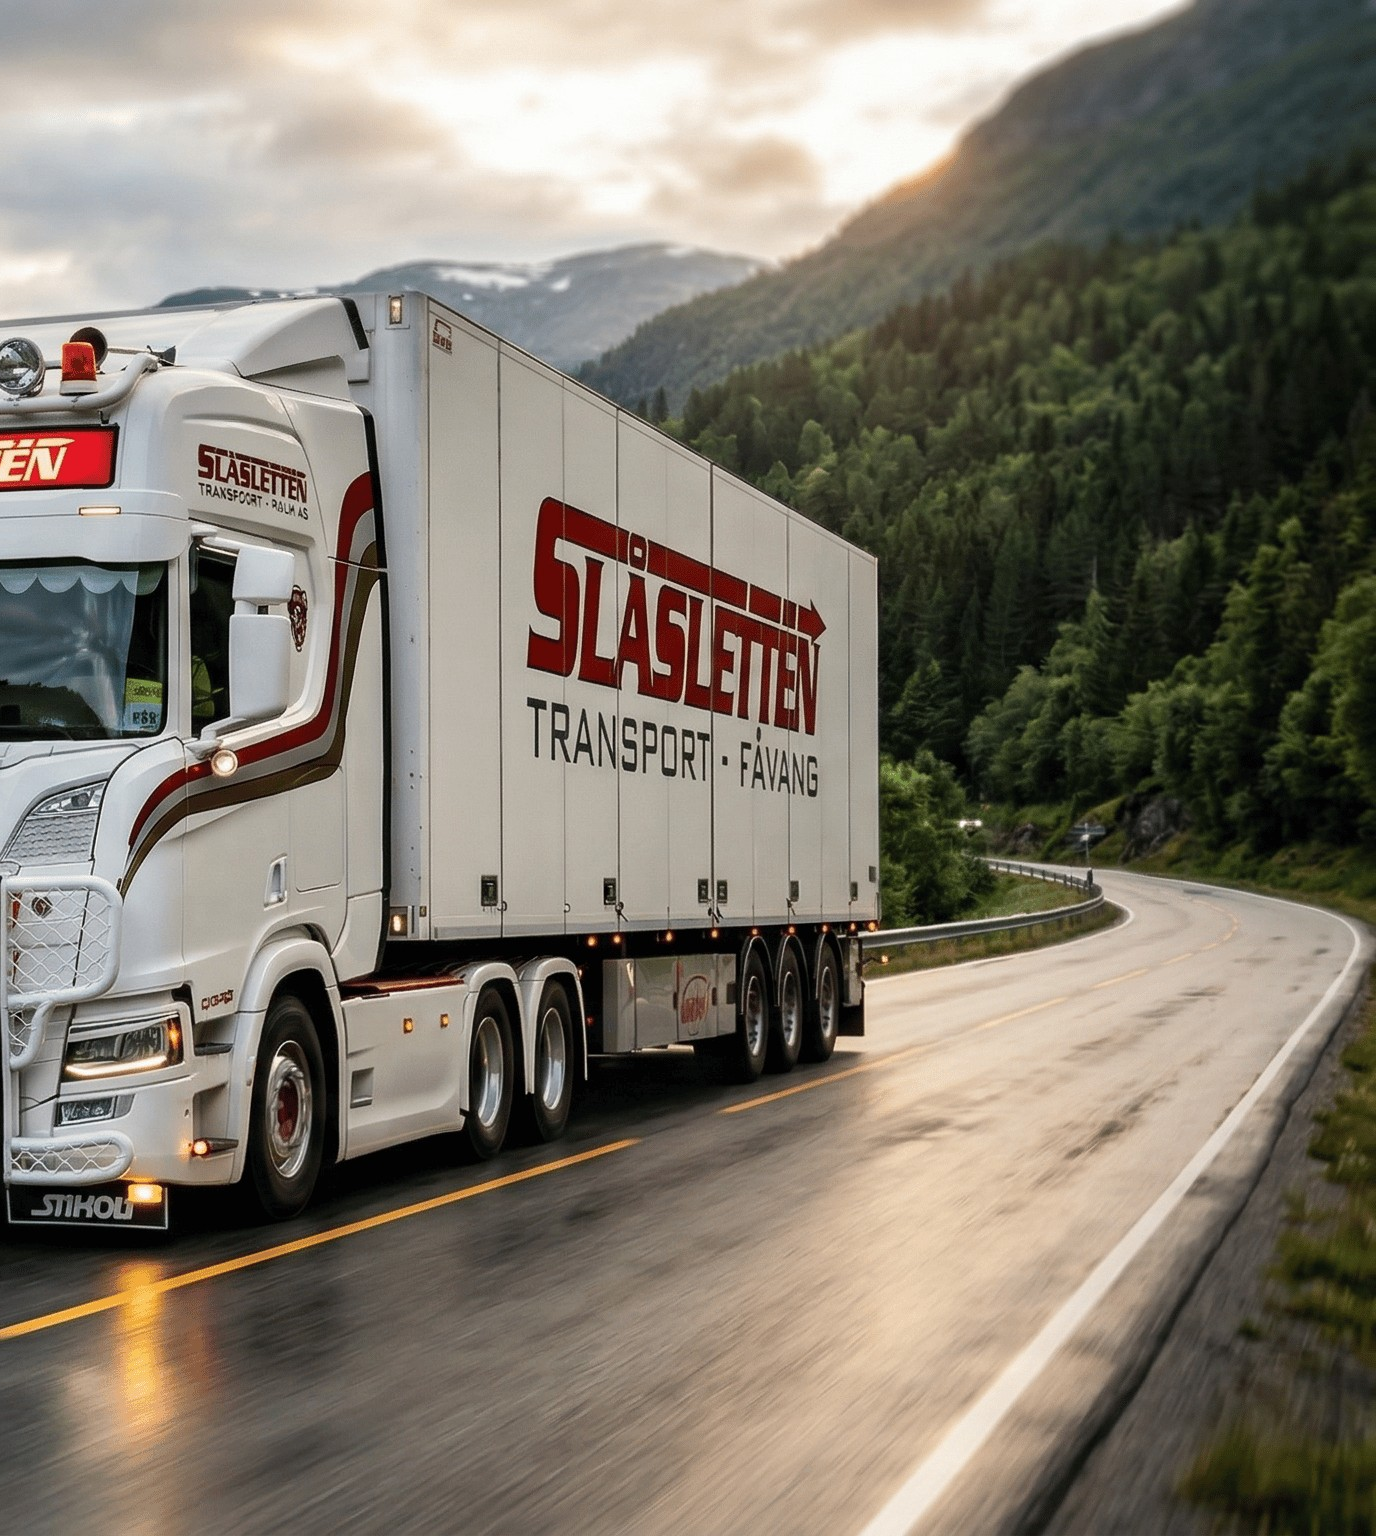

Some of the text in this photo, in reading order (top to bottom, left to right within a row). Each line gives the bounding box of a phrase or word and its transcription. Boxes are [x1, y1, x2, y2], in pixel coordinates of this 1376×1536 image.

[527, 496, 827, 736] SLÅSLETTEN
[527, 697, 711, 782] TRANSPORT
[740, 727, 819, 798] FÅVANG
